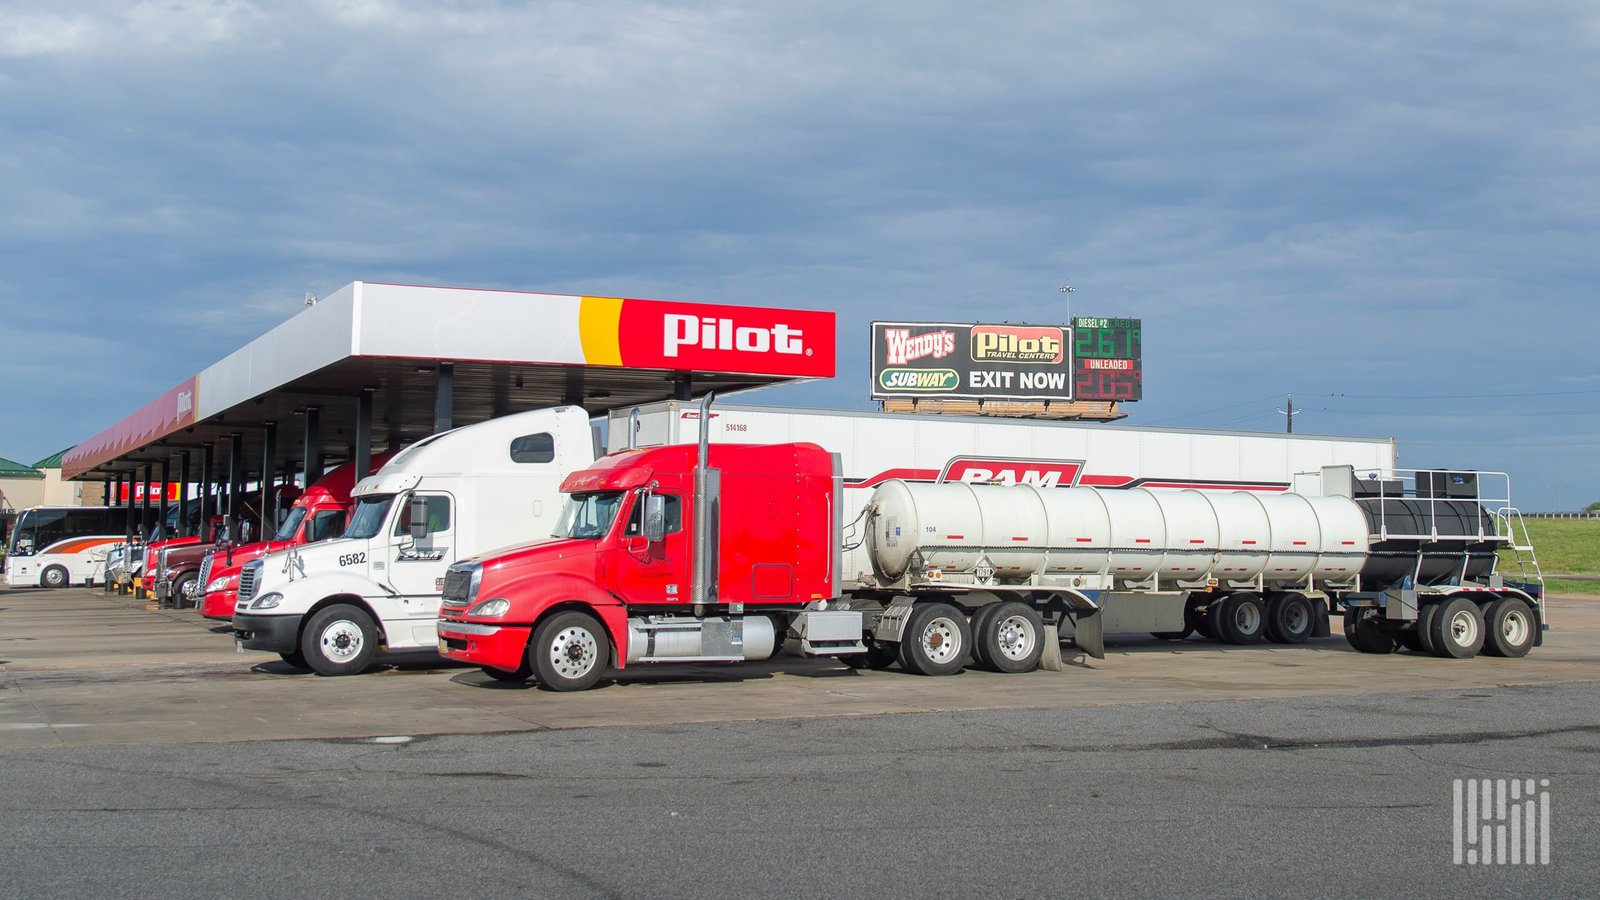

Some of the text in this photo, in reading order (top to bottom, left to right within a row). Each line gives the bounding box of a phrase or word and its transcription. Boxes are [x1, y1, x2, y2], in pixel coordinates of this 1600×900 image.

[1078, 319, 1099, 328] DIESEL
[1100, 319, 1108, 328] #2
[663, 313, 803, 357] Pilot
[884, 328, 955, 365] Wendy's
[977, 332, 1060, 358] Pilot
[986, 351, 1056, 360] TRAVEL CENTERS
[1090, 359, 1128, 370] UNLEADED
[885, 371, 954, 387] SUBWAY
[969, 371, 1066, 390] EXIT NOW
[726, 424, 748, 432] 514168
[339, 552, 367, 567] 6582
